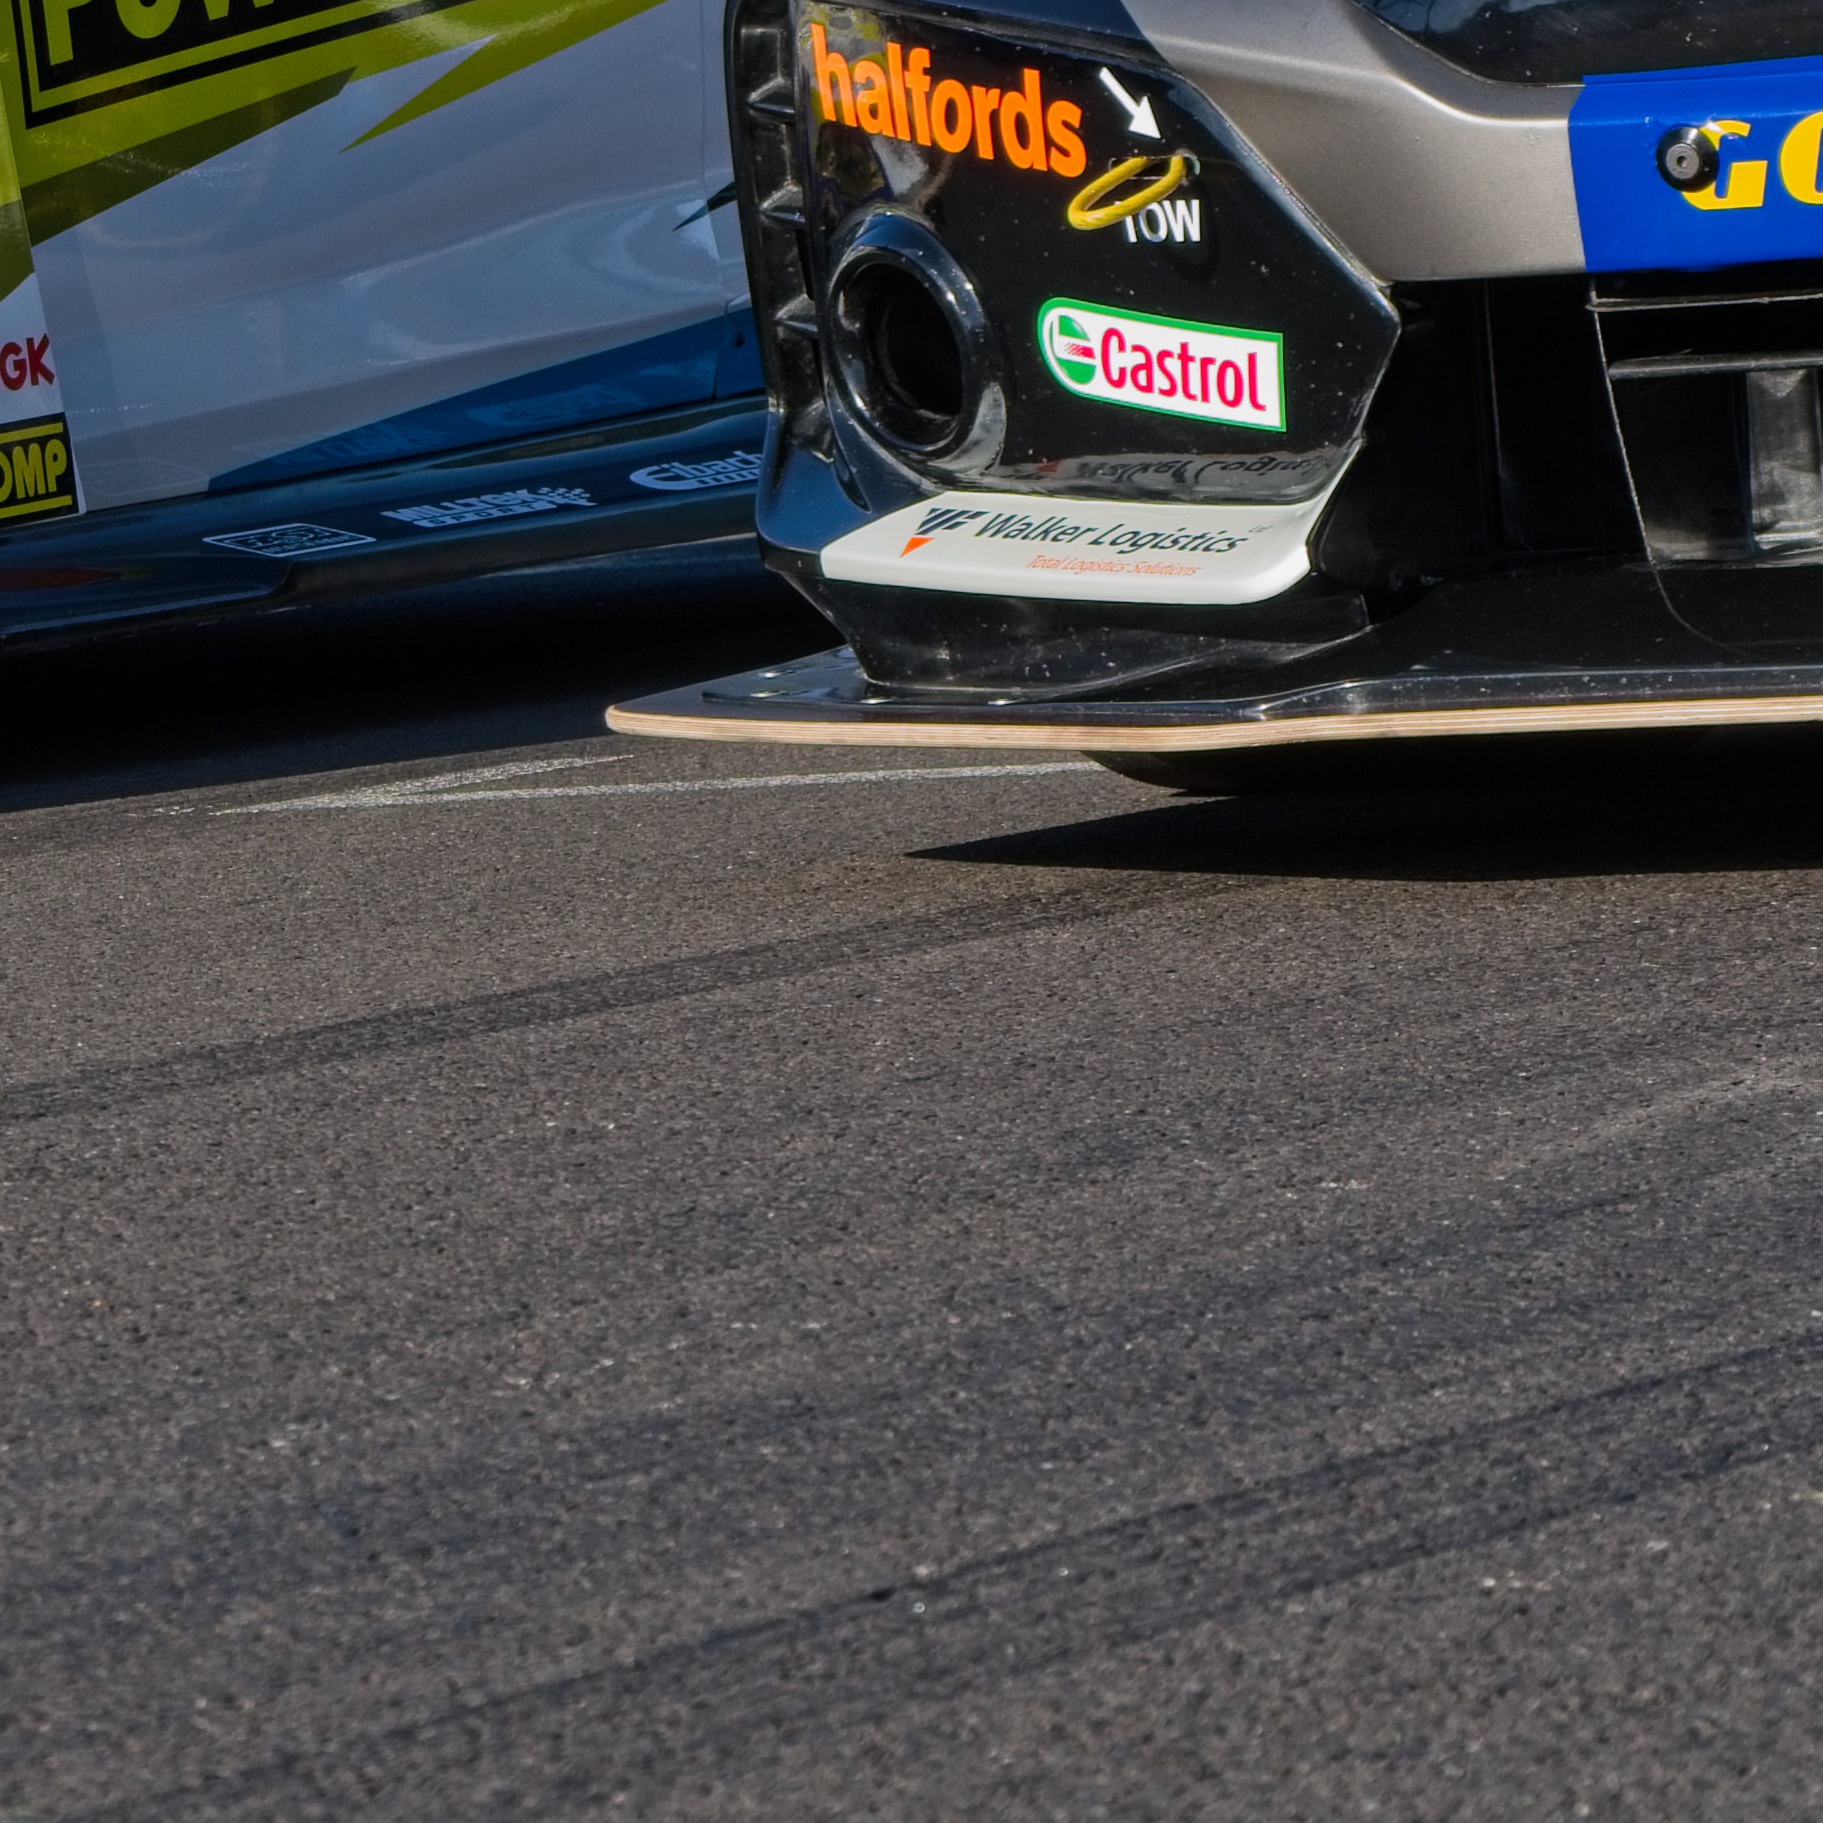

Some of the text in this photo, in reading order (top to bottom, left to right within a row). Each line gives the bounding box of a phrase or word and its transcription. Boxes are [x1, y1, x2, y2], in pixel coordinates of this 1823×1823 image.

[810, 22, 1088, 178] halfords
[1100, 327, 1267, 414] Castrol
[380, 488, 538, 522] MILLTEK
[974, 512, 1100, 544] Walker
[1088, 523, 1250, 555] Logistics
[1027, 554, 1203, 576] Total Logistics Solutions
